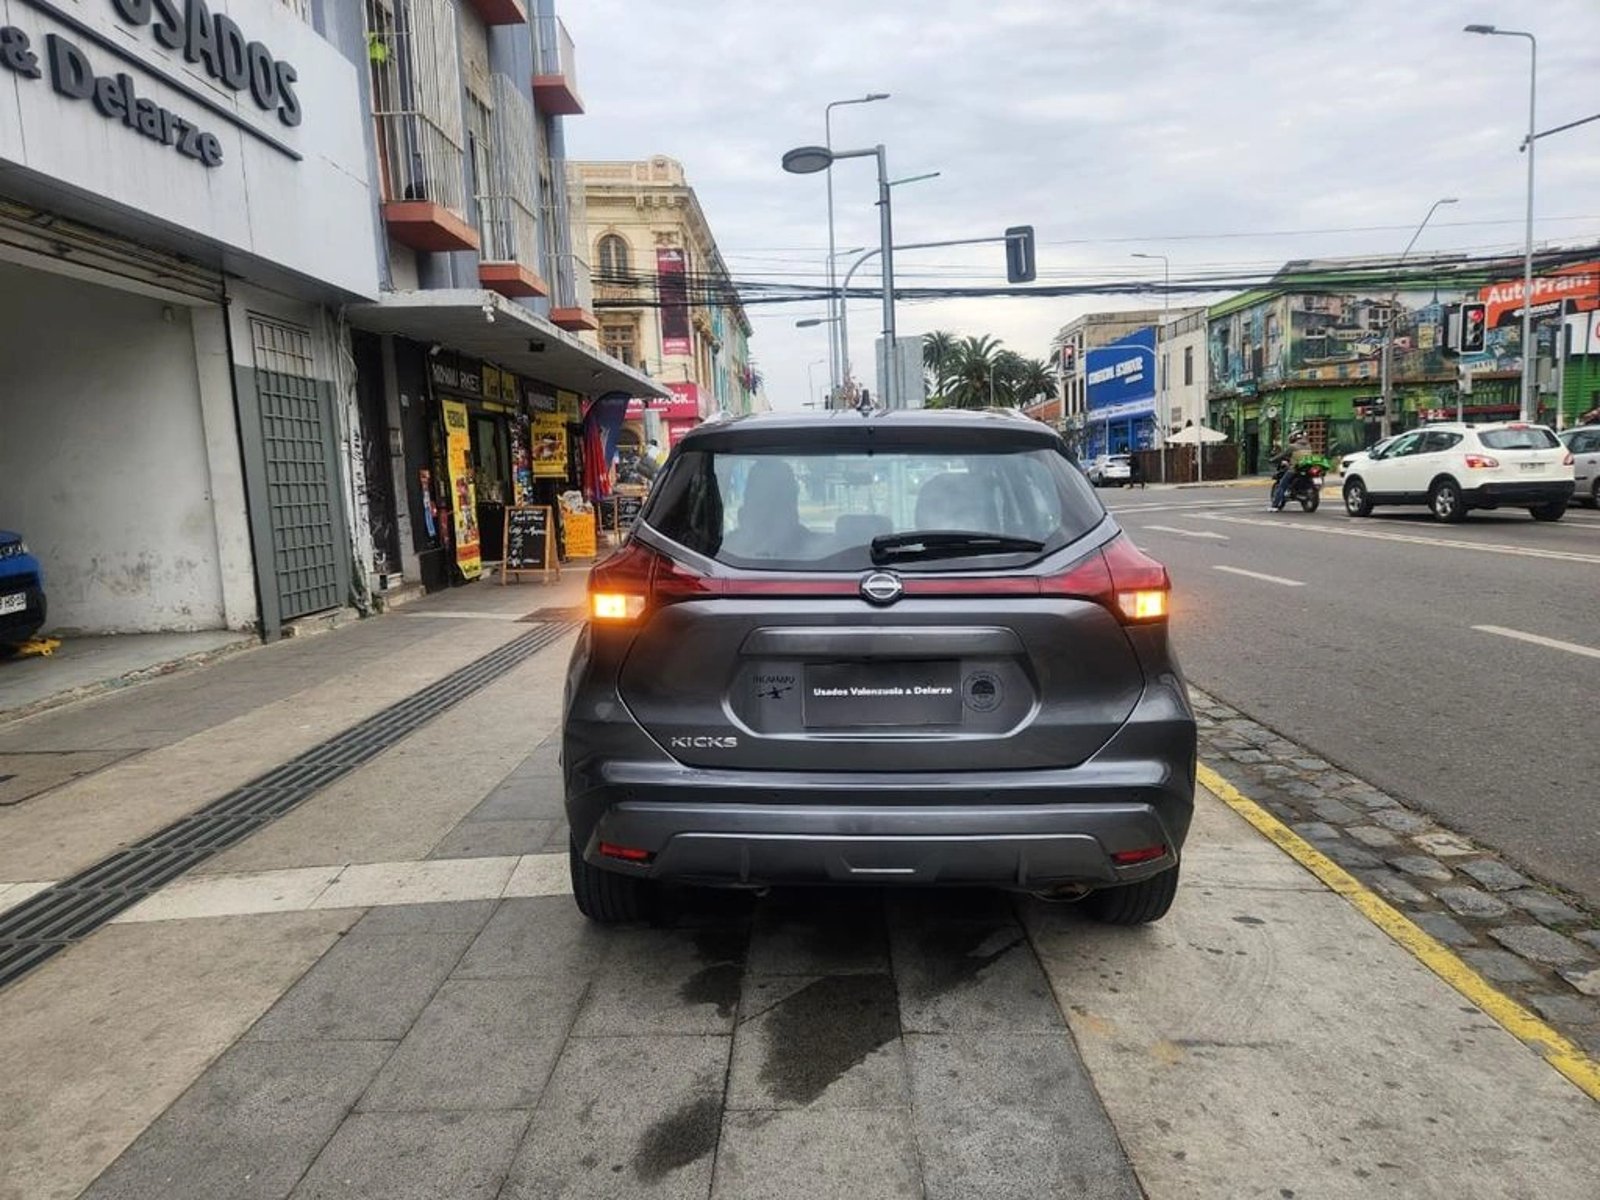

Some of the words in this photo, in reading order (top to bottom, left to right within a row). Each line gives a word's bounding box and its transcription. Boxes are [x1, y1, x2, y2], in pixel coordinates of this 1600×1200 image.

[0, 26, 42, 79] &
[46, 33, 224, 167] Delarze
[112, 0, 302, 127] SADOS
[813, 687, 849, 696] Usados
[850, 686, 904, 696] Valenzuela
[913, 683, 953, 695] Delarze
[670, 736, 738, 748] KICKS
